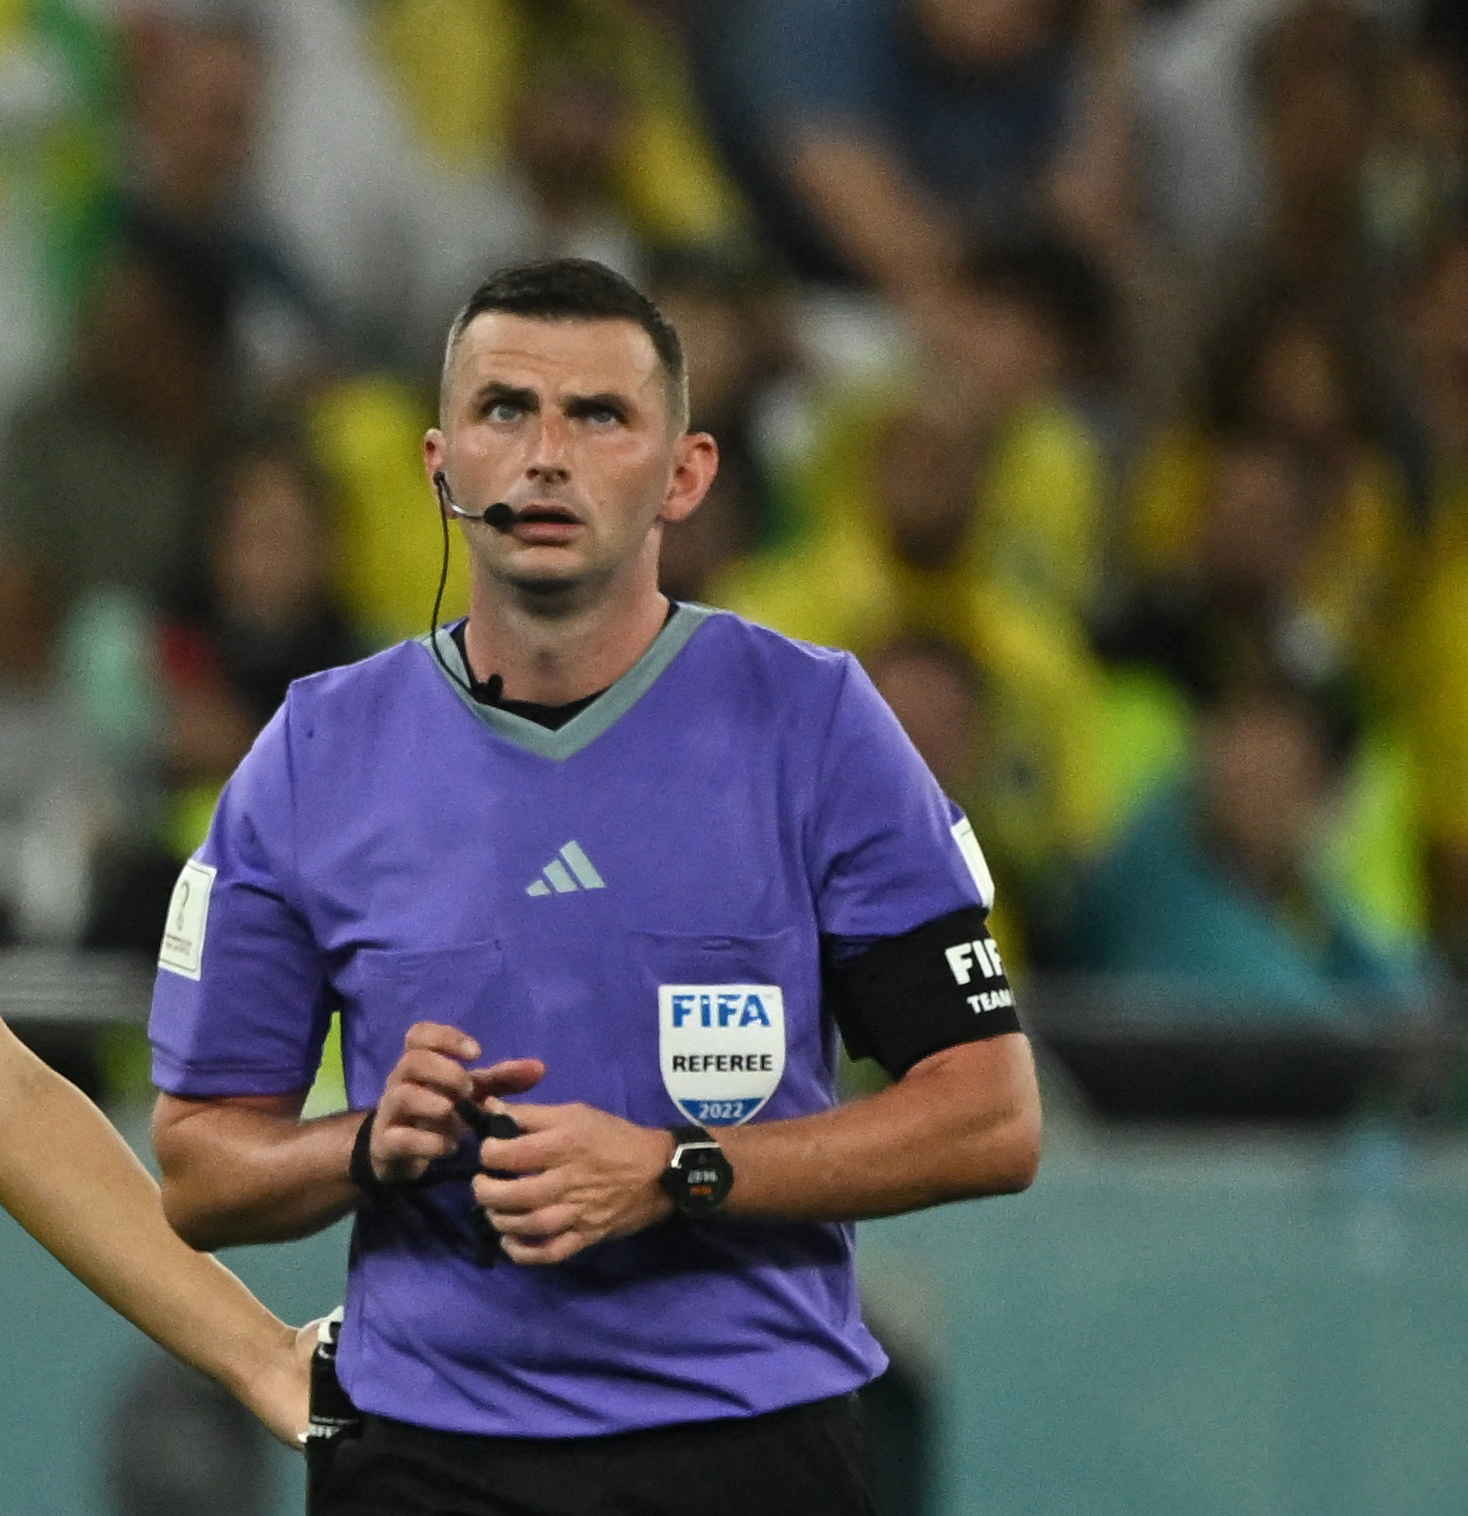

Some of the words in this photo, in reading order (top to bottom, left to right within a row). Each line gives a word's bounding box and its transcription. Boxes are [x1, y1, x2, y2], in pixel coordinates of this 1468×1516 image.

[671, 993, 771, 1029] FIFA
[672, 1053, 773, 1073] REFEREE
[698, 1103, 743, 1120] 2022
